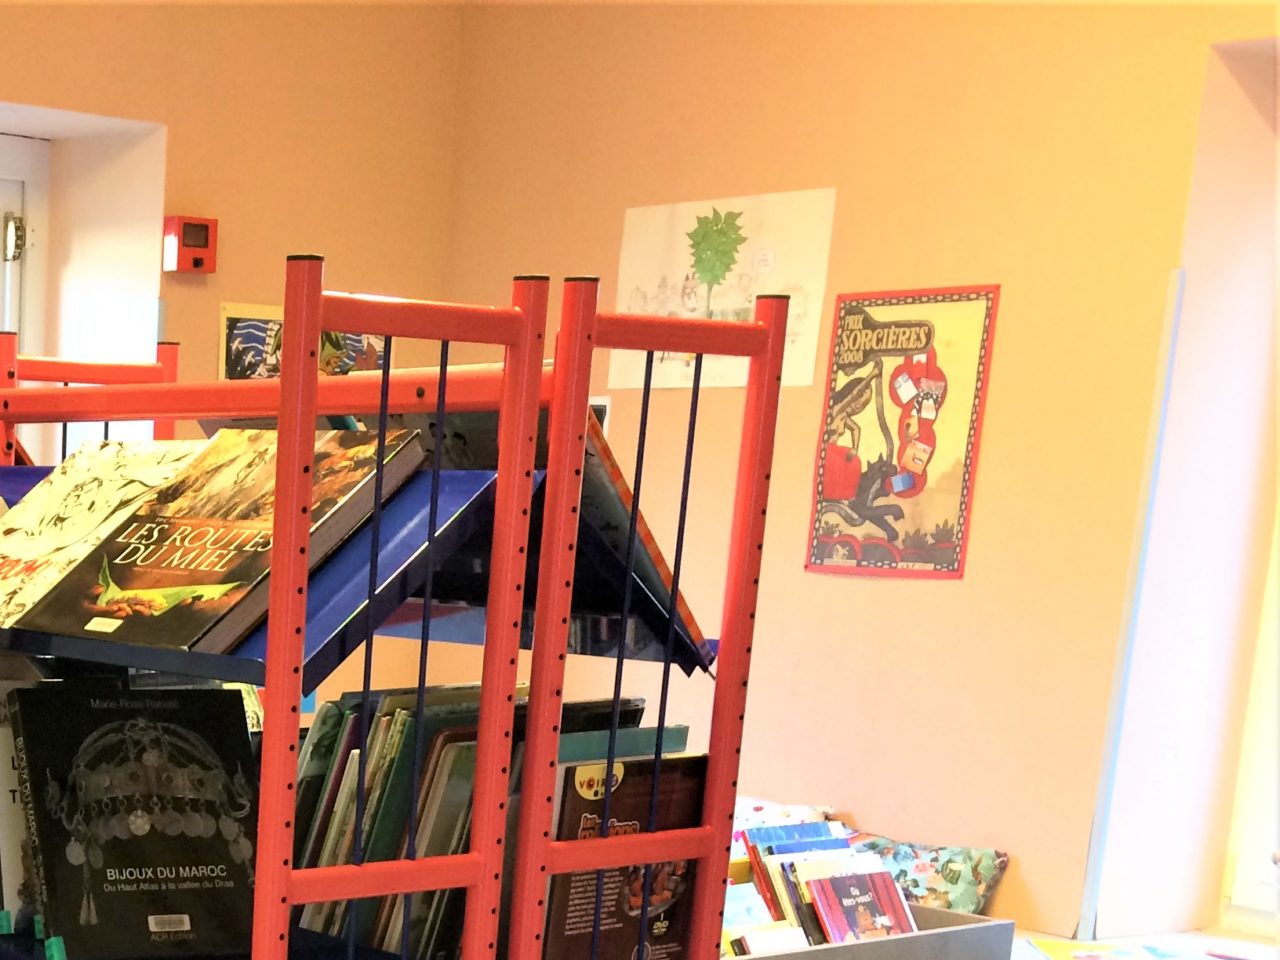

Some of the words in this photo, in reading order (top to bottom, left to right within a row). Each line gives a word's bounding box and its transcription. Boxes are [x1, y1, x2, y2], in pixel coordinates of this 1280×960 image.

[115, 522, 169, 544] LES
[163, 525, 273, 552] ROUTES
[113, 543, 168, 566] DU
[161, 547, 239, 572] MIEL
[106, 867, 155, 880] BIJOUX
[157, 866, 176, 878] DU
[180, 865, 227, 878] MAROC
[103, 884, 116, 892] Du
[117, 883, 138, 891] Haut
[140, 882, 159, 891] Atlas
